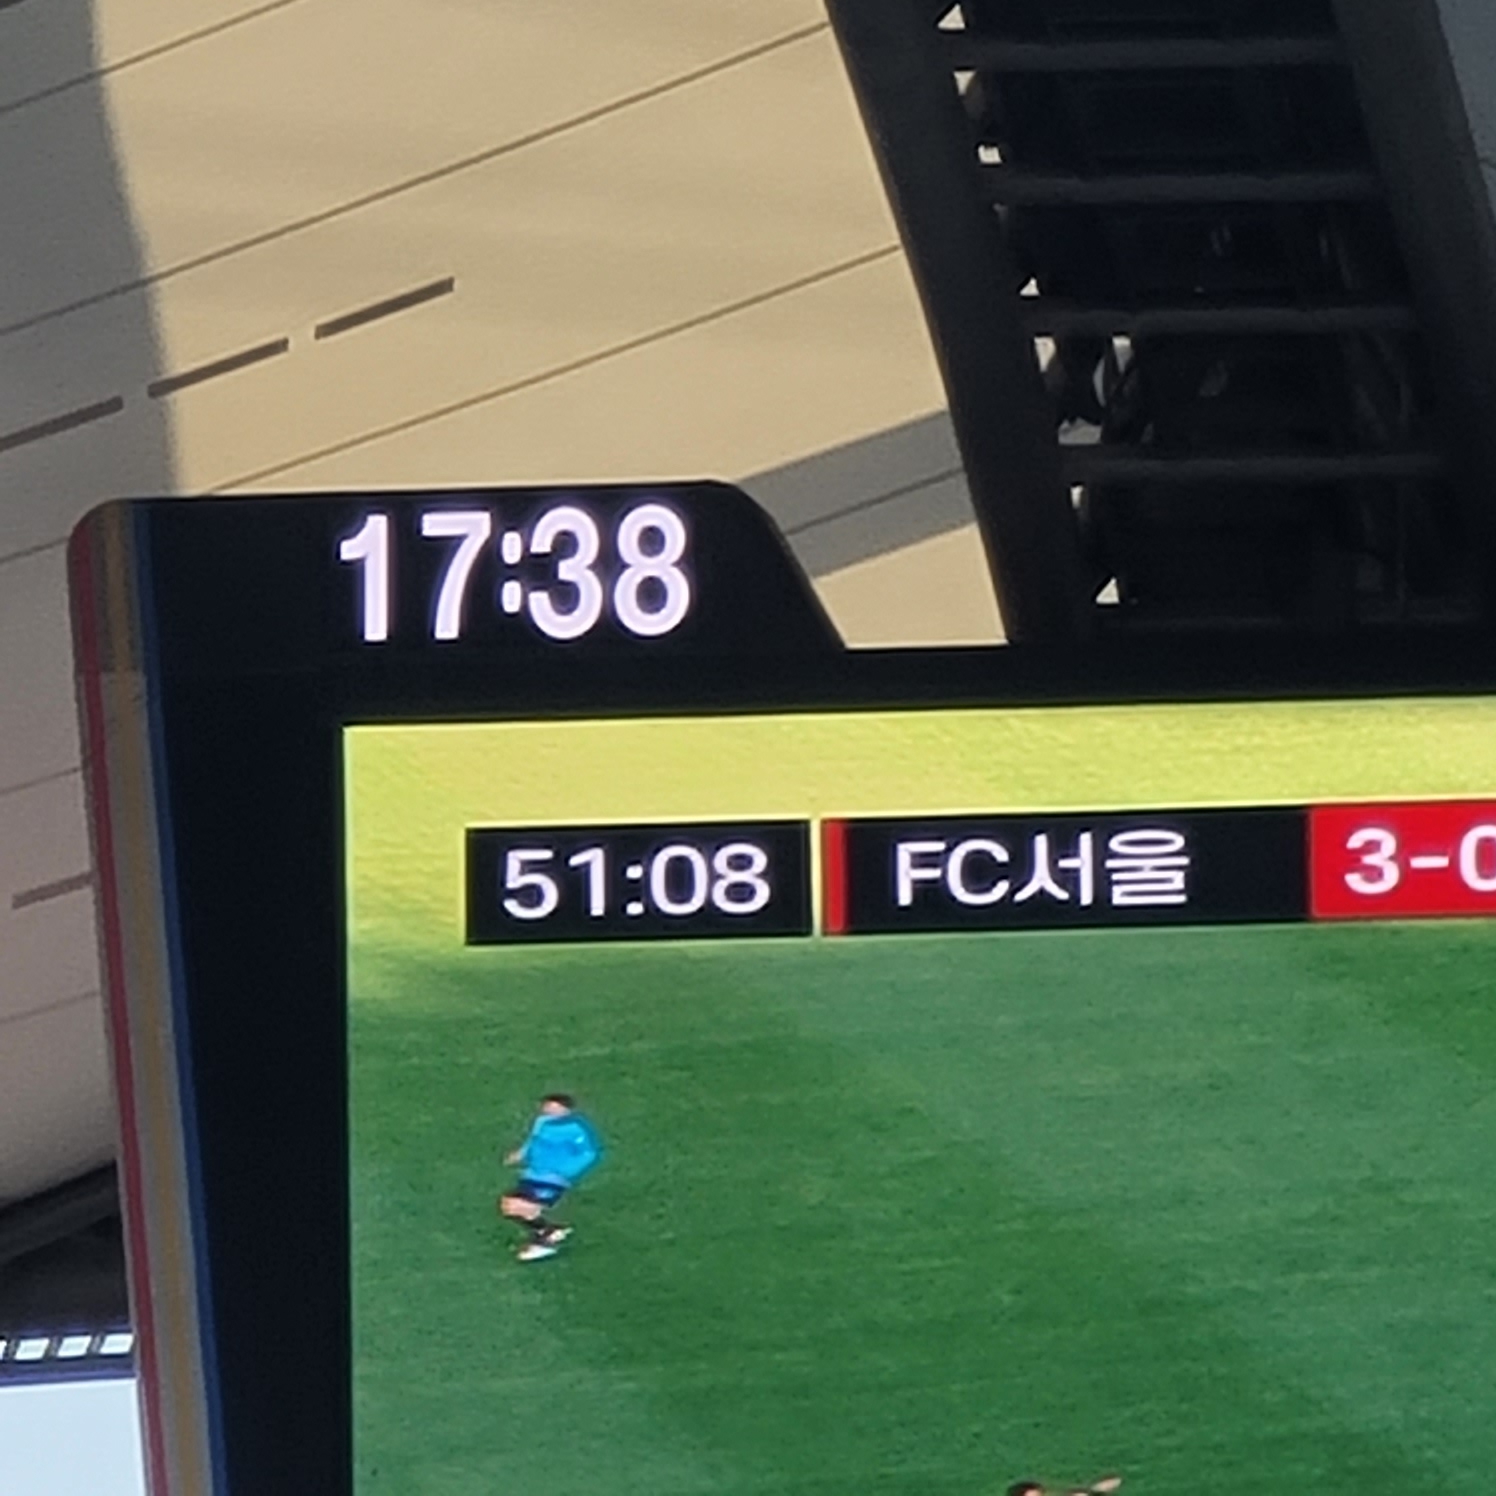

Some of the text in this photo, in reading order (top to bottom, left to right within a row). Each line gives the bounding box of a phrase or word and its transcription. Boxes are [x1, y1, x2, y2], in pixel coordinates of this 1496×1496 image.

[338, 502, 691, 643] 17:38
[501, 842, 773, 920] 51:08
[896, 828, 1192, 907] FC서울
